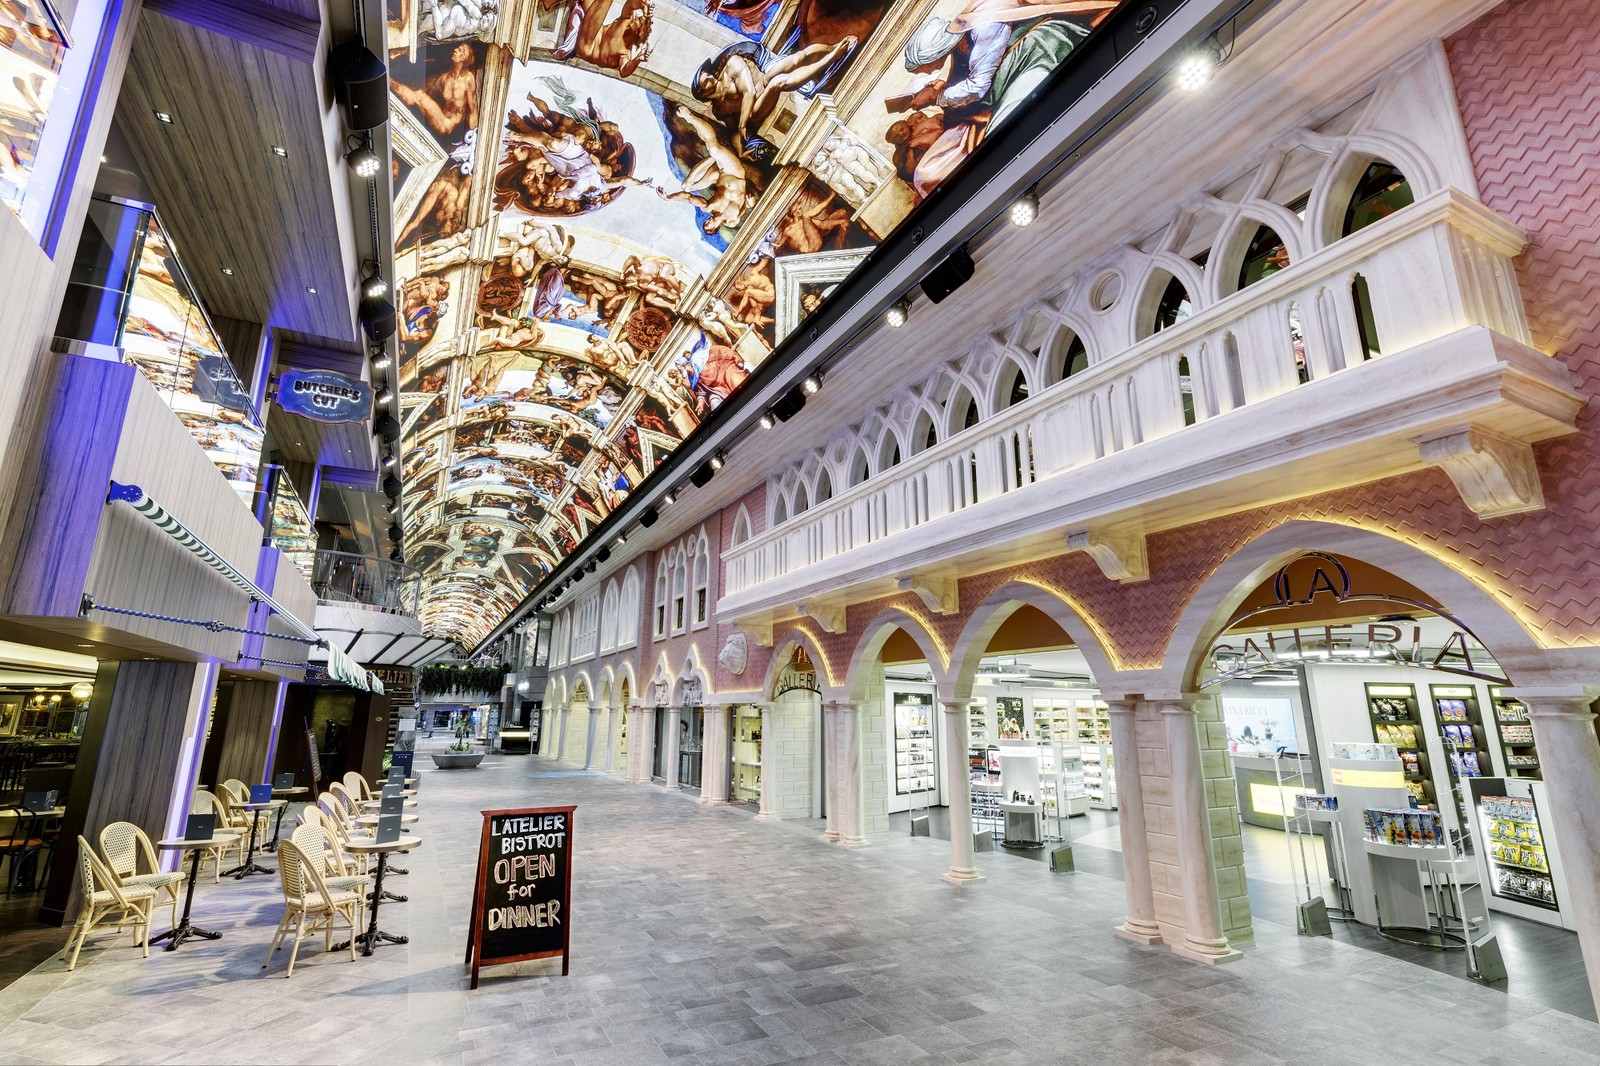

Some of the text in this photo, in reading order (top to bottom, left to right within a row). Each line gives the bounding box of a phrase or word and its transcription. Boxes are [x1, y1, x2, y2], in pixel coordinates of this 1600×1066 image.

[293, 380, 361, 403] BUTCHER'S
[312, 393, 340, 410] CUT
[1282, 566, 1342, 607] LA
[1210, 623, 1474, 673] GALLERIA
[492, 815, 565, 836] L'ATELIER
[502, 832, 566, 854] BISTROT
[494, 853, 555, 884] OPEN
[507, 883, 536, 900] for
[488, 899, 561, 931] DINNER
